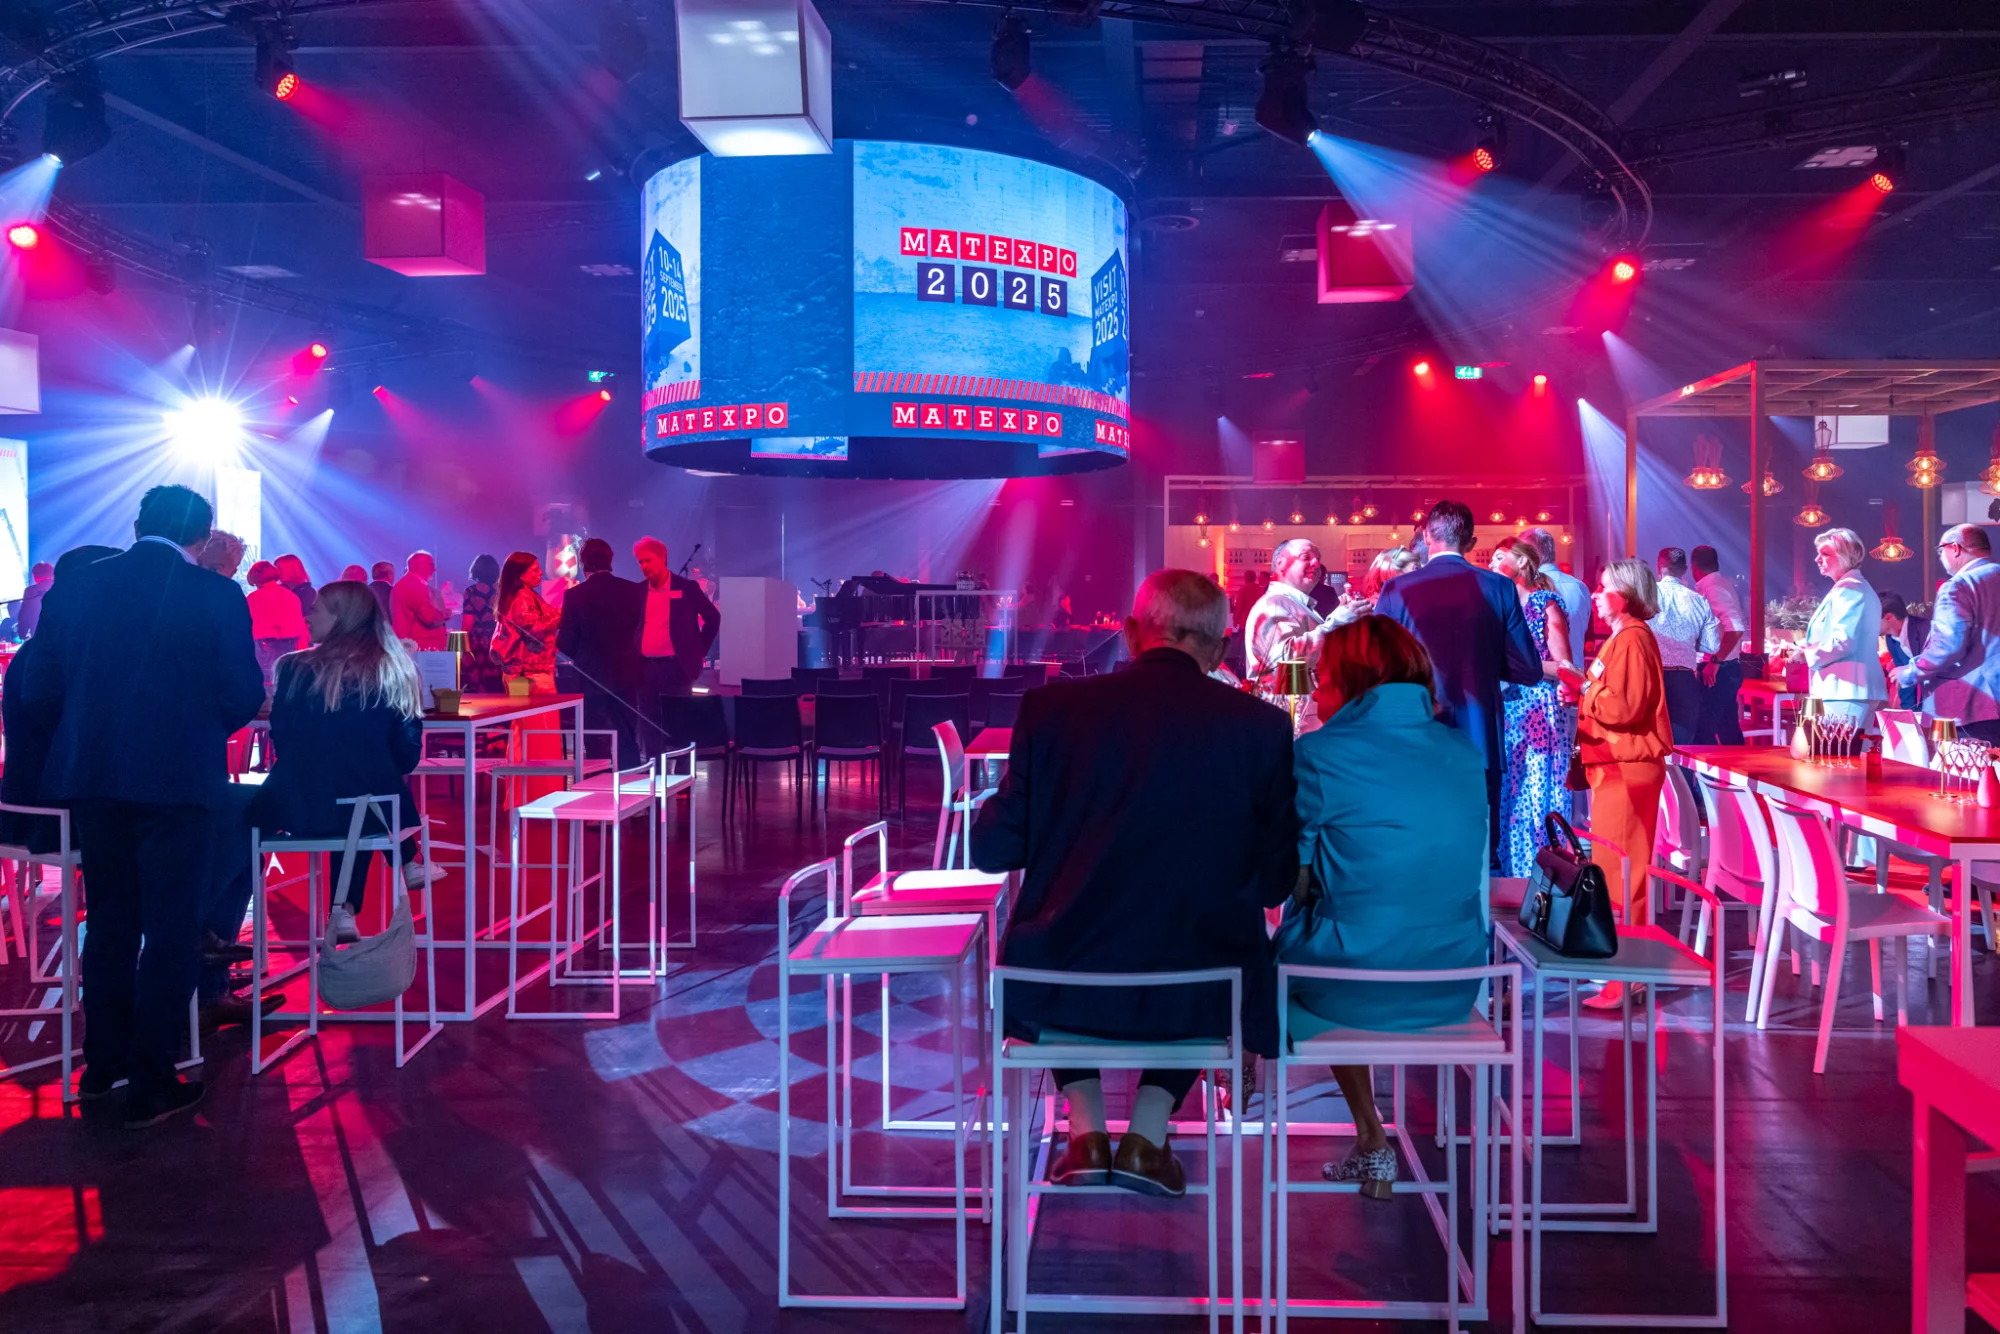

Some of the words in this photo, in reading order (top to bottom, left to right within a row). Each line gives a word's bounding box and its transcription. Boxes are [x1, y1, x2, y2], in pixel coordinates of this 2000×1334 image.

[659, 245, 682, 281] 10-14
[903, 232, 1075, 272] MATEXPO
[660, 270, 684, 294] SEPTEMBER
[927, 268, 1061, 310] 2025
[1094, 264, 1117, 303] VISIT
[661, 286, 687, 323] 2025
[1095, 306, 1119, 347] 2025
[657, 407, 785, 434] MATEXPO
[895, 407, 1060, 433] MATEXPO
[1096, 423, 1130, 448] MATE
